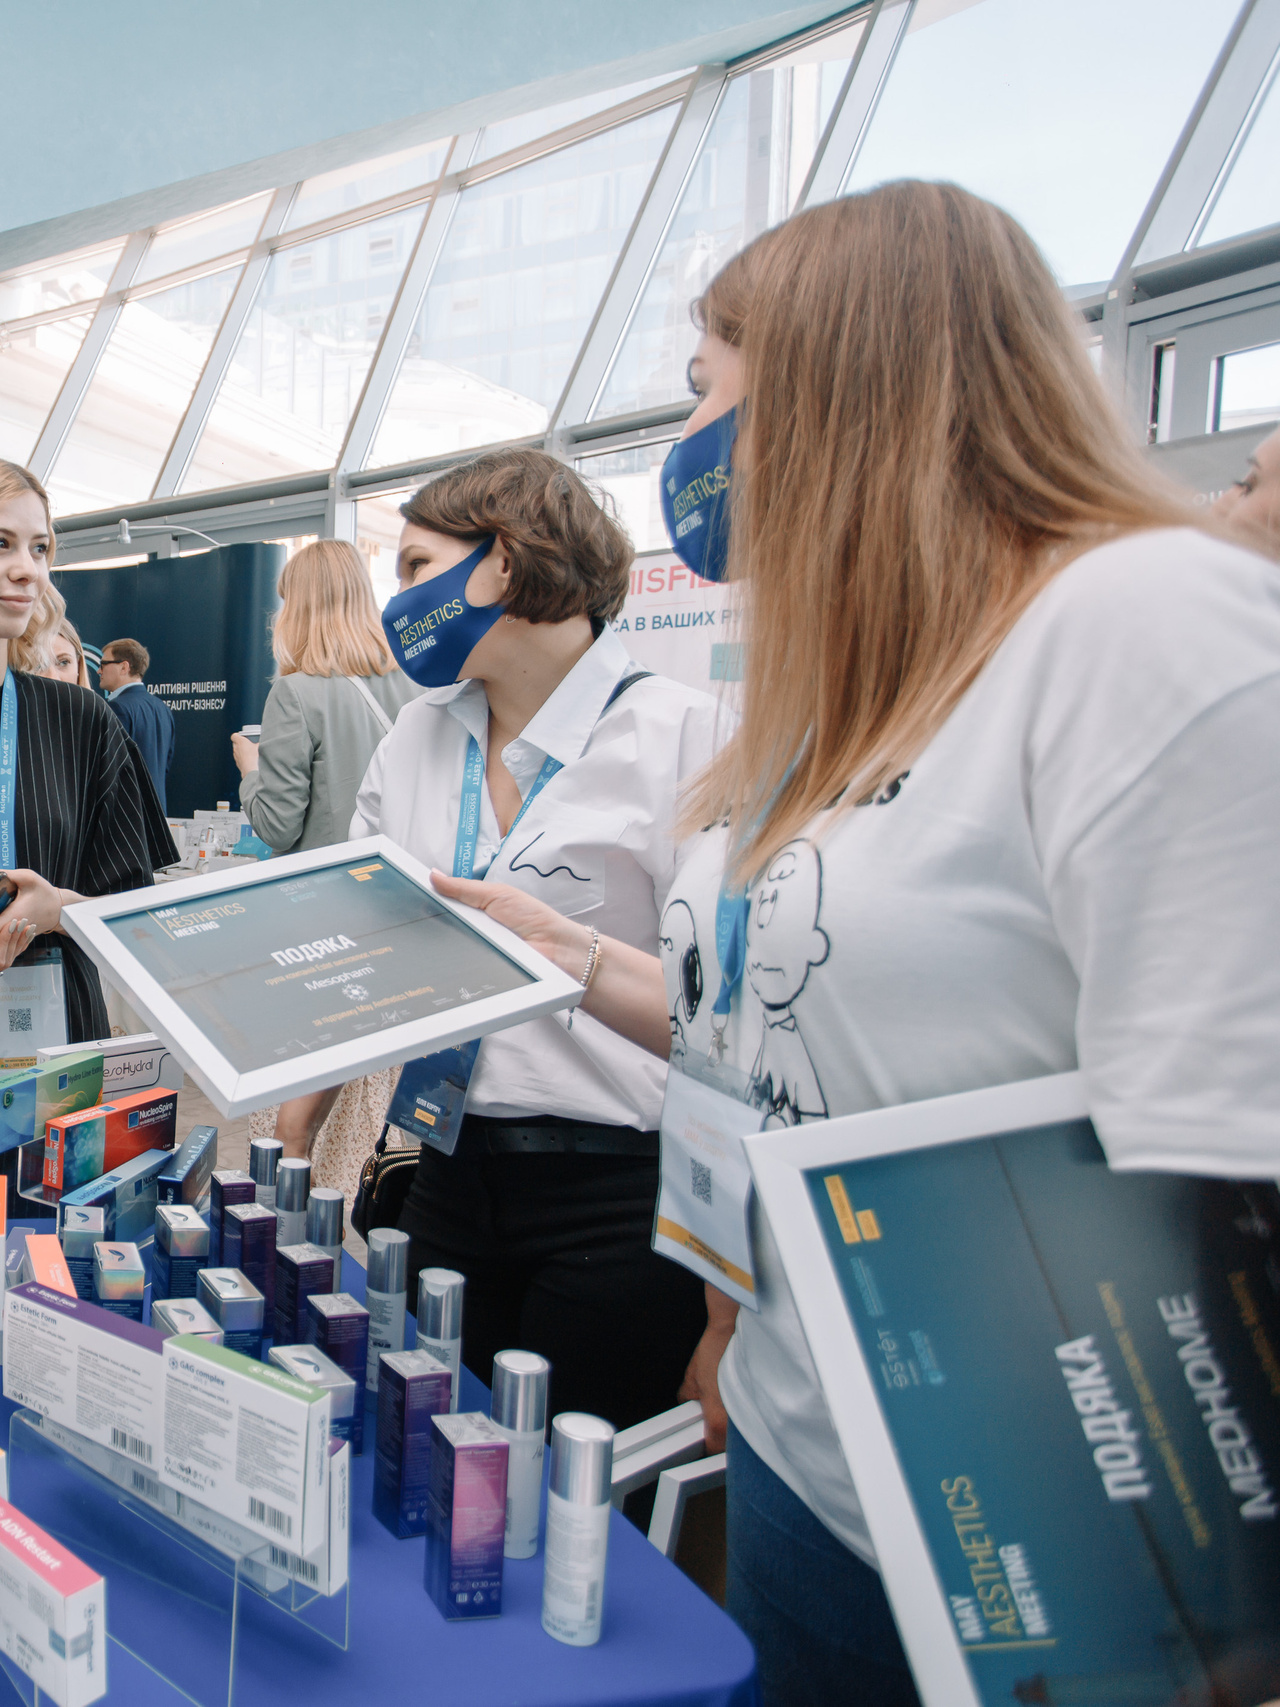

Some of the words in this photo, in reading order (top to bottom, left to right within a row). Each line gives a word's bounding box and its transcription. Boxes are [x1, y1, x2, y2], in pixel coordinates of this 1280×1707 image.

[673, 465, 730, 522] AESTHETICS
[676, 510, 703, 540] MEETING
[393, 615, 409, 632] MAY
[399, 599, 464, 648] AESTHETICS
[652, 610, 715, 630] ВАШИХ
[404, 635, 437, 661] MEETING
[191, 681, 226, 693] РІШЕННЯ
[472, 764, 482, 786] ESTET
[467, 793, 478, 836] association
[1, 820, 10, 867] MEDHOME
[155, 907, 178, 919] MAY
[165, 903, 246, 930] AESTHETICS
[173, 920, 220, 939] MEETING
[270, 934, 357, 967] ПОДЯКА
[304, 965, 375, 992] Mesopharm
[68, 1073, 81, 1084] Hydro
[139, 1102, 173, 1119] NucleoSpire
[20, 1304, 41, 1318] Estetic
[41, 1311, 57, 1325] Form
[179, 1361, 195, 1373] GAG
[195, 1366, 225, 1386] complex
[1054, 1332, 1153, 1502] ПОДЯКА
[1156, 1292, 1278, 1520] MEDHOME
[163, 1466, 205, 1493] Mesopharm
[19, 1534, 62, 1571] Restart
[941, 1474, 1021, 1637] AESTHETICS
[998, 1541, 1051, 1637] MEETING
[950, 1593, 985, 1642] MAY
